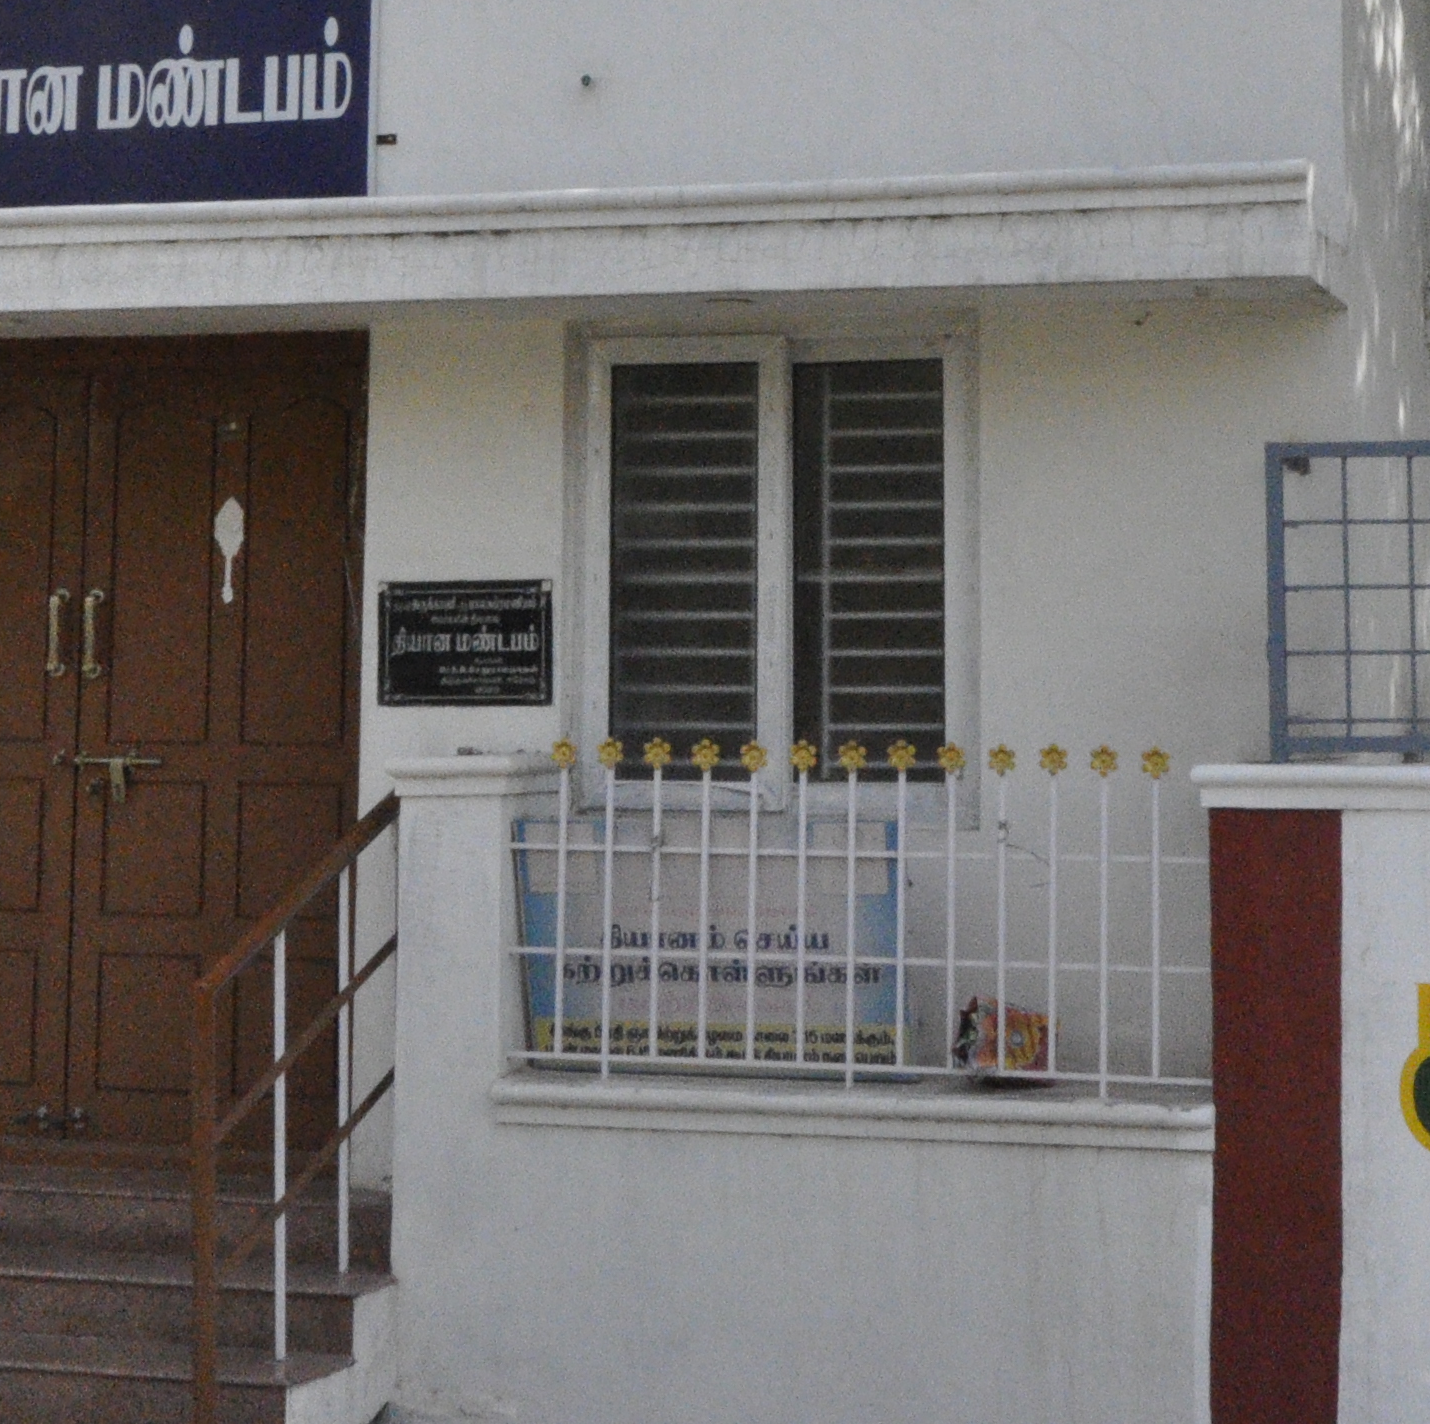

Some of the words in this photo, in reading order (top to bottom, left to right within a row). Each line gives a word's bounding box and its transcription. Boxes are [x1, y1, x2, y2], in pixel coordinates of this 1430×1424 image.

[96, 16, 352, 131] மண்டபம்
[390, 626, 451, 658] தியான
[455, 624, 540, 653] மண்டபம்
